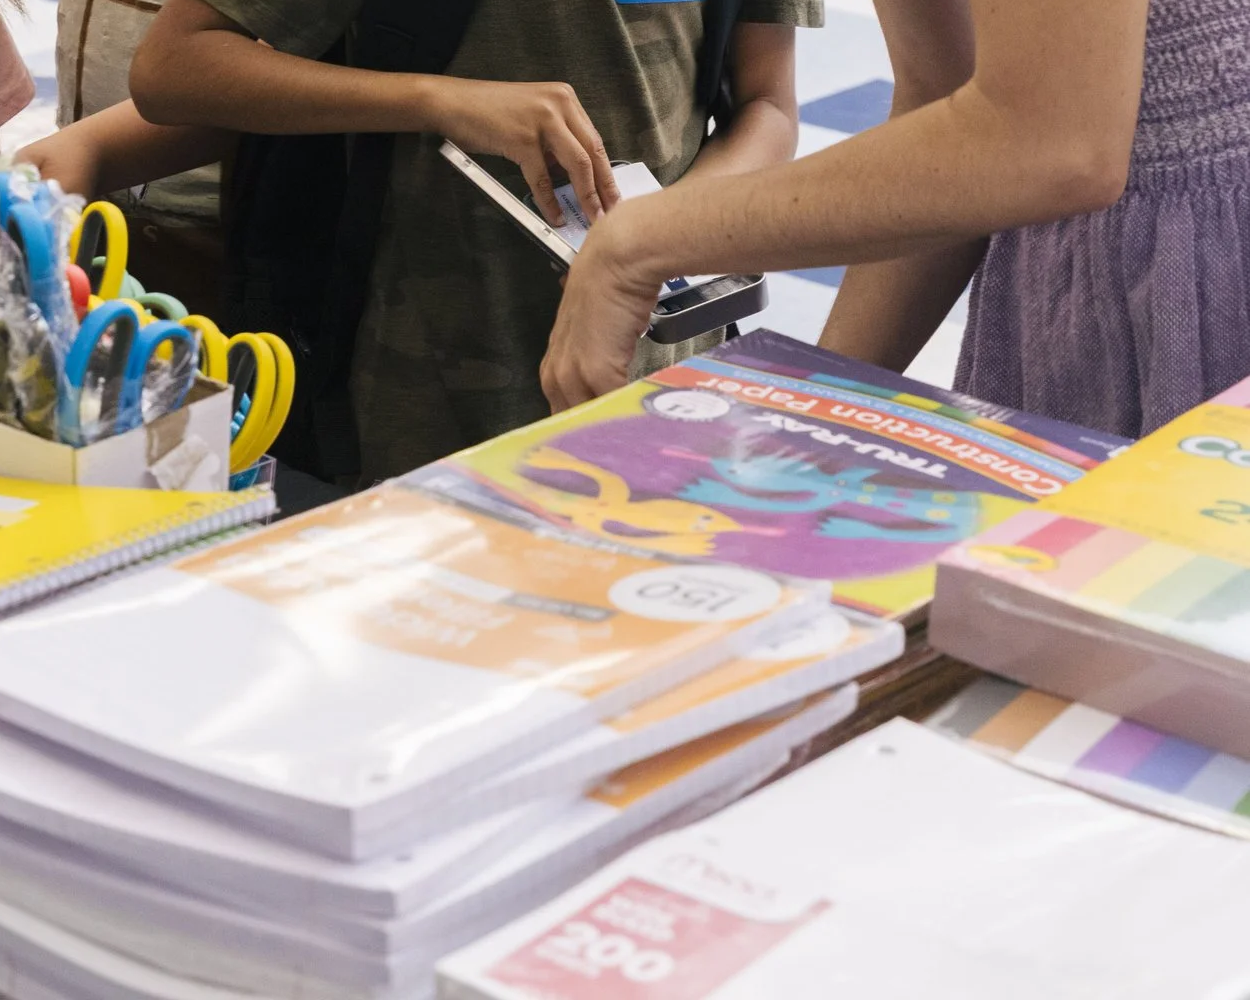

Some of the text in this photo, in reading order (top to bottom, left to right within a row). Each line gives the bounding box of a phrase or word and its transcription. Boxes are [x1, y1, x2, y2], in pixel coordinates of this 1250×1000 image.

[695, 377, 1063, 497] Construction Paper
[753, 411, 949, 478] TRU-RAY
[552, 920, 676, 983] 200
